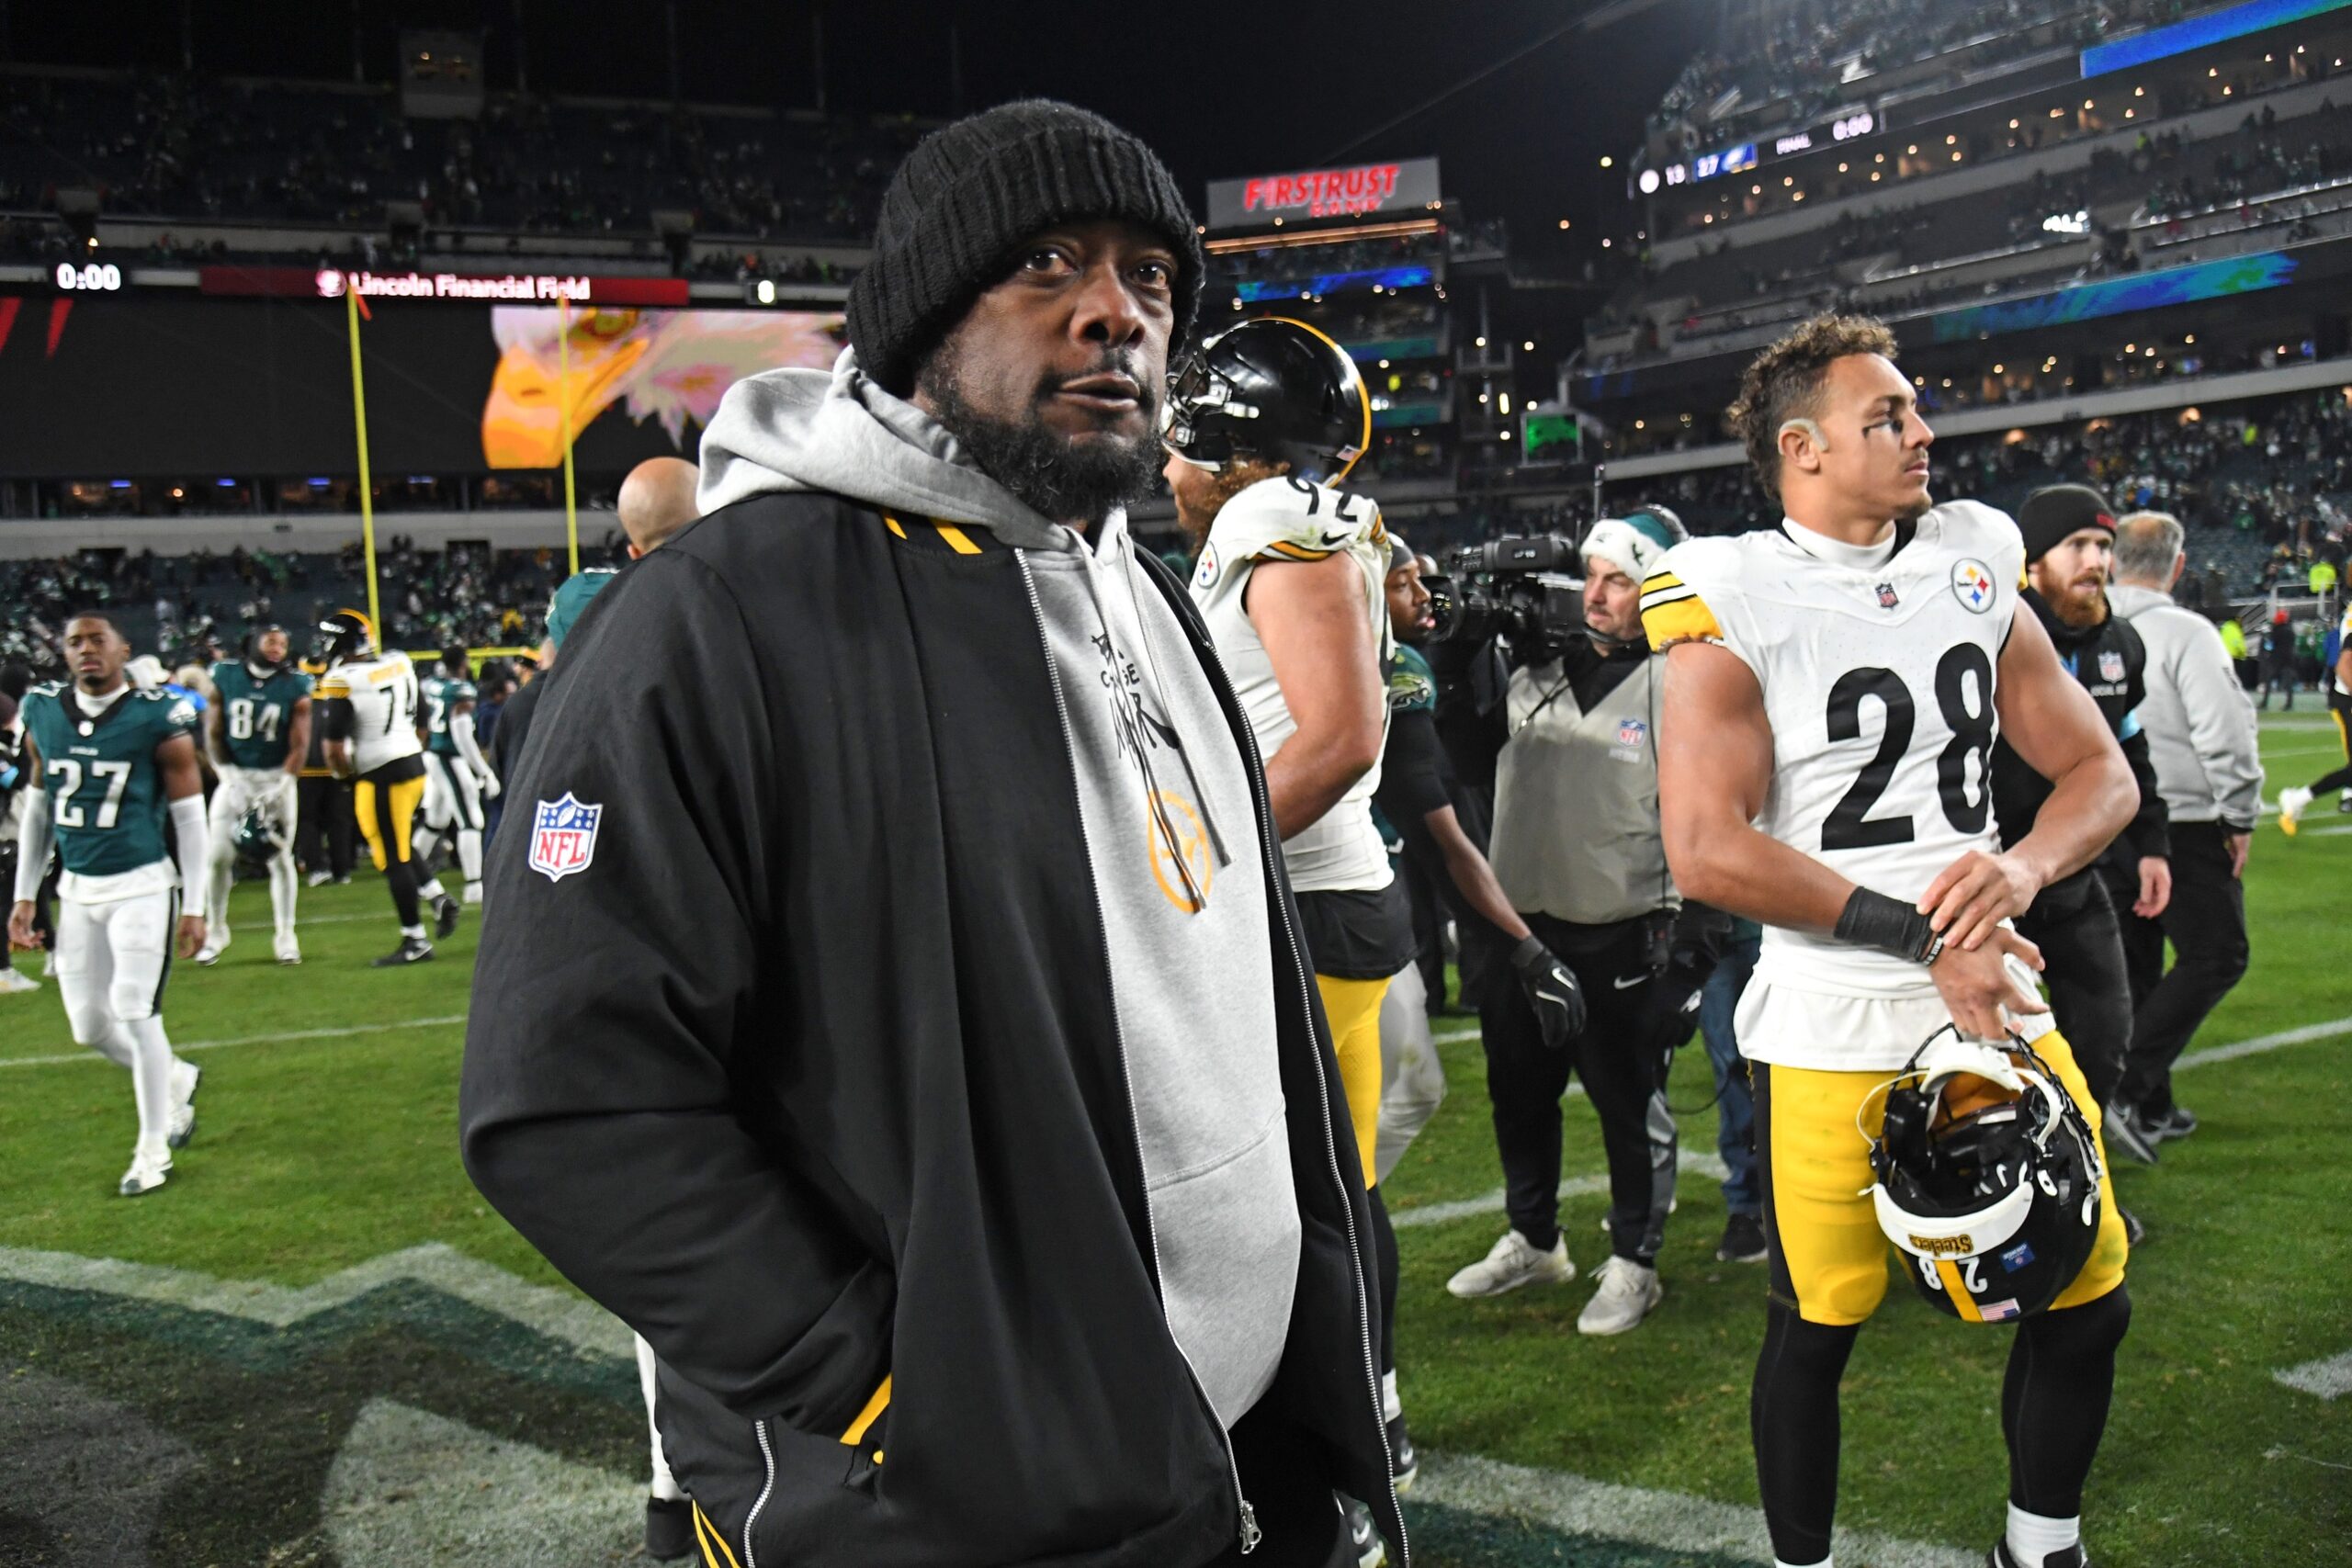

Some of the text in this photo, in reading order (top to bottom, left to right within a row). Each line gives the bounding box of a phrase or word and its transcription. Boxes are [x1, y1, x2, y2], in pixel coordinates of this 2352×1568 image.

[1697, 154, 1719, 178] 27
[1244, 164, 1400, 211] FIRSTRUST
[57, 263, 121, 290] 0:00
[348, 271, 434, 296] Lincoln
[435, 274, 536, 299] Financial
[1286, 476, 1358, 523] 92
[230, 698, 282, 742] 84
[1821, 642, 1999, 851] 28
[48, 759, 132, 828] 27
[537, 831, 586, 868] NFL
[1907, 1234, 1973, 1258] Steelers
[1918, 1256, 1988, 1293] 28
